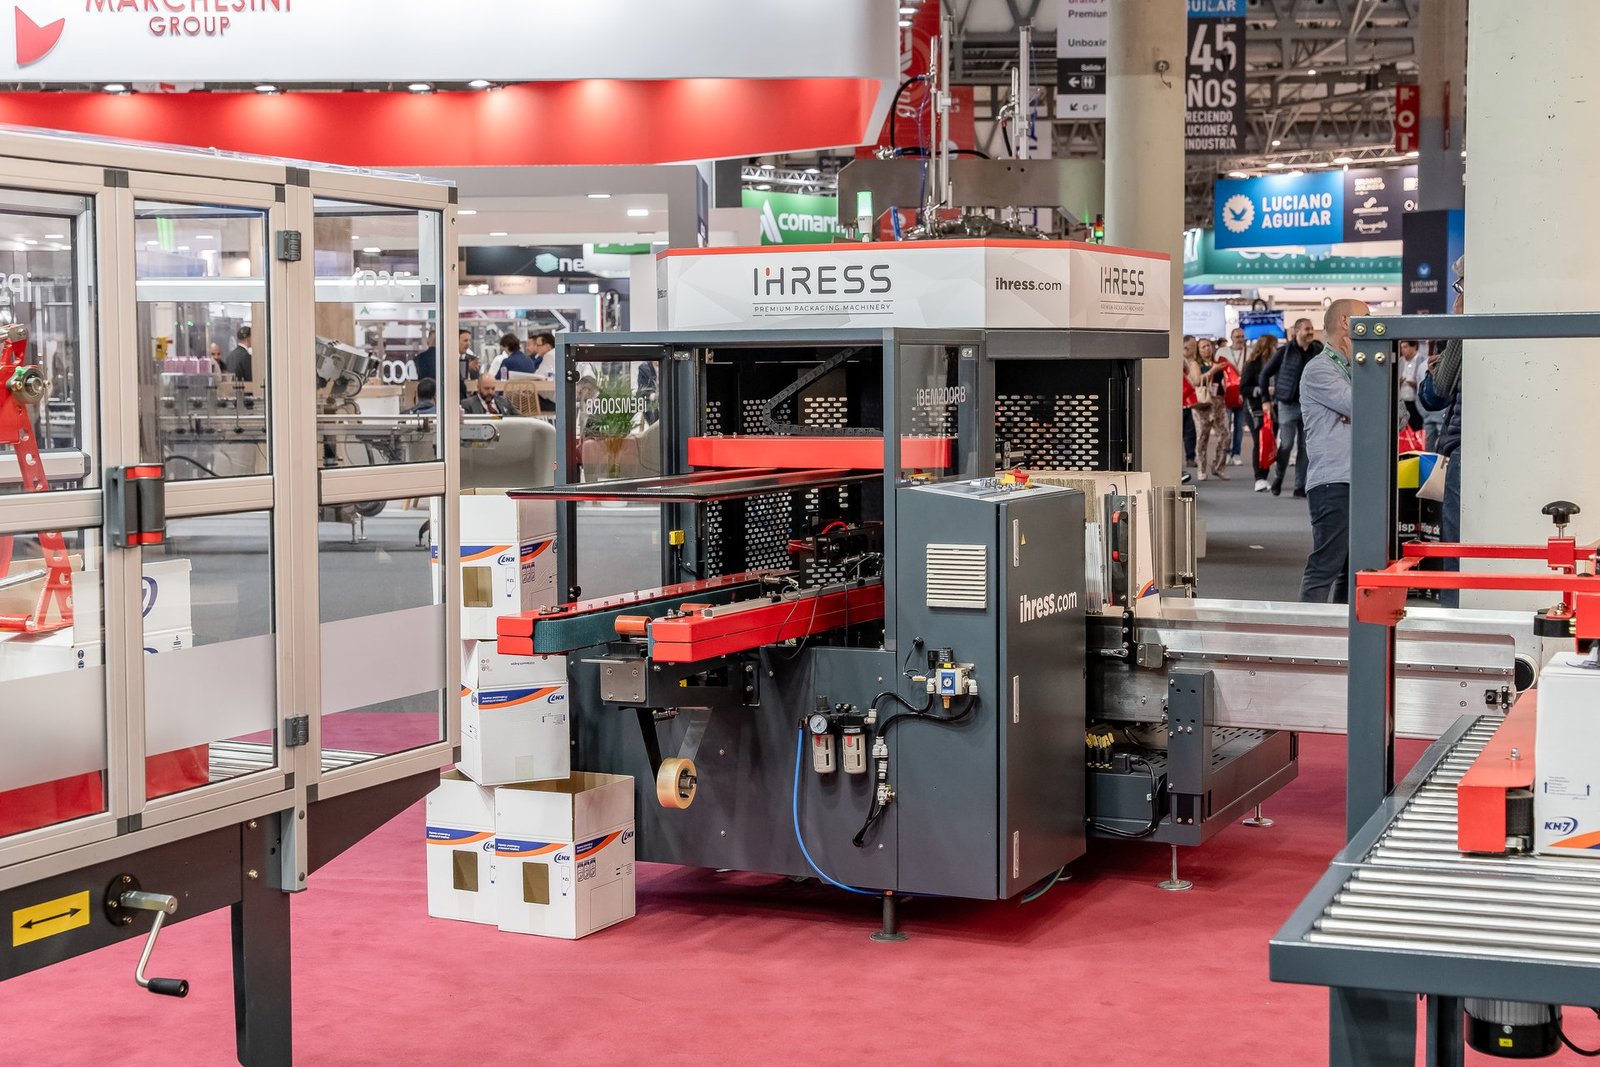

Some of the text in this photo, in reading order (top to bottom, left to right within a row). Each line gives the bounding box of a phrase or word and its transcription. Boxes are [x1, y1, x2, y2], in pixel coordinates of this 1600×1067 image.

[149, 16, 231, 36] GROUP
[1190, 24, 1237, 73] 45
[1230, 124, 1237, 135] A
[1262, 192, 1332, 212] LUCIANO
[1261, 210, 1331, 229] AGUILAR
[995, 277, 1062, 291] ihress.com
[842, 303, 891, 311] MACHINERY
[916, 386, 966, 407] iBEM200RB
[1019, 590, 1077, 623] ihress.com
